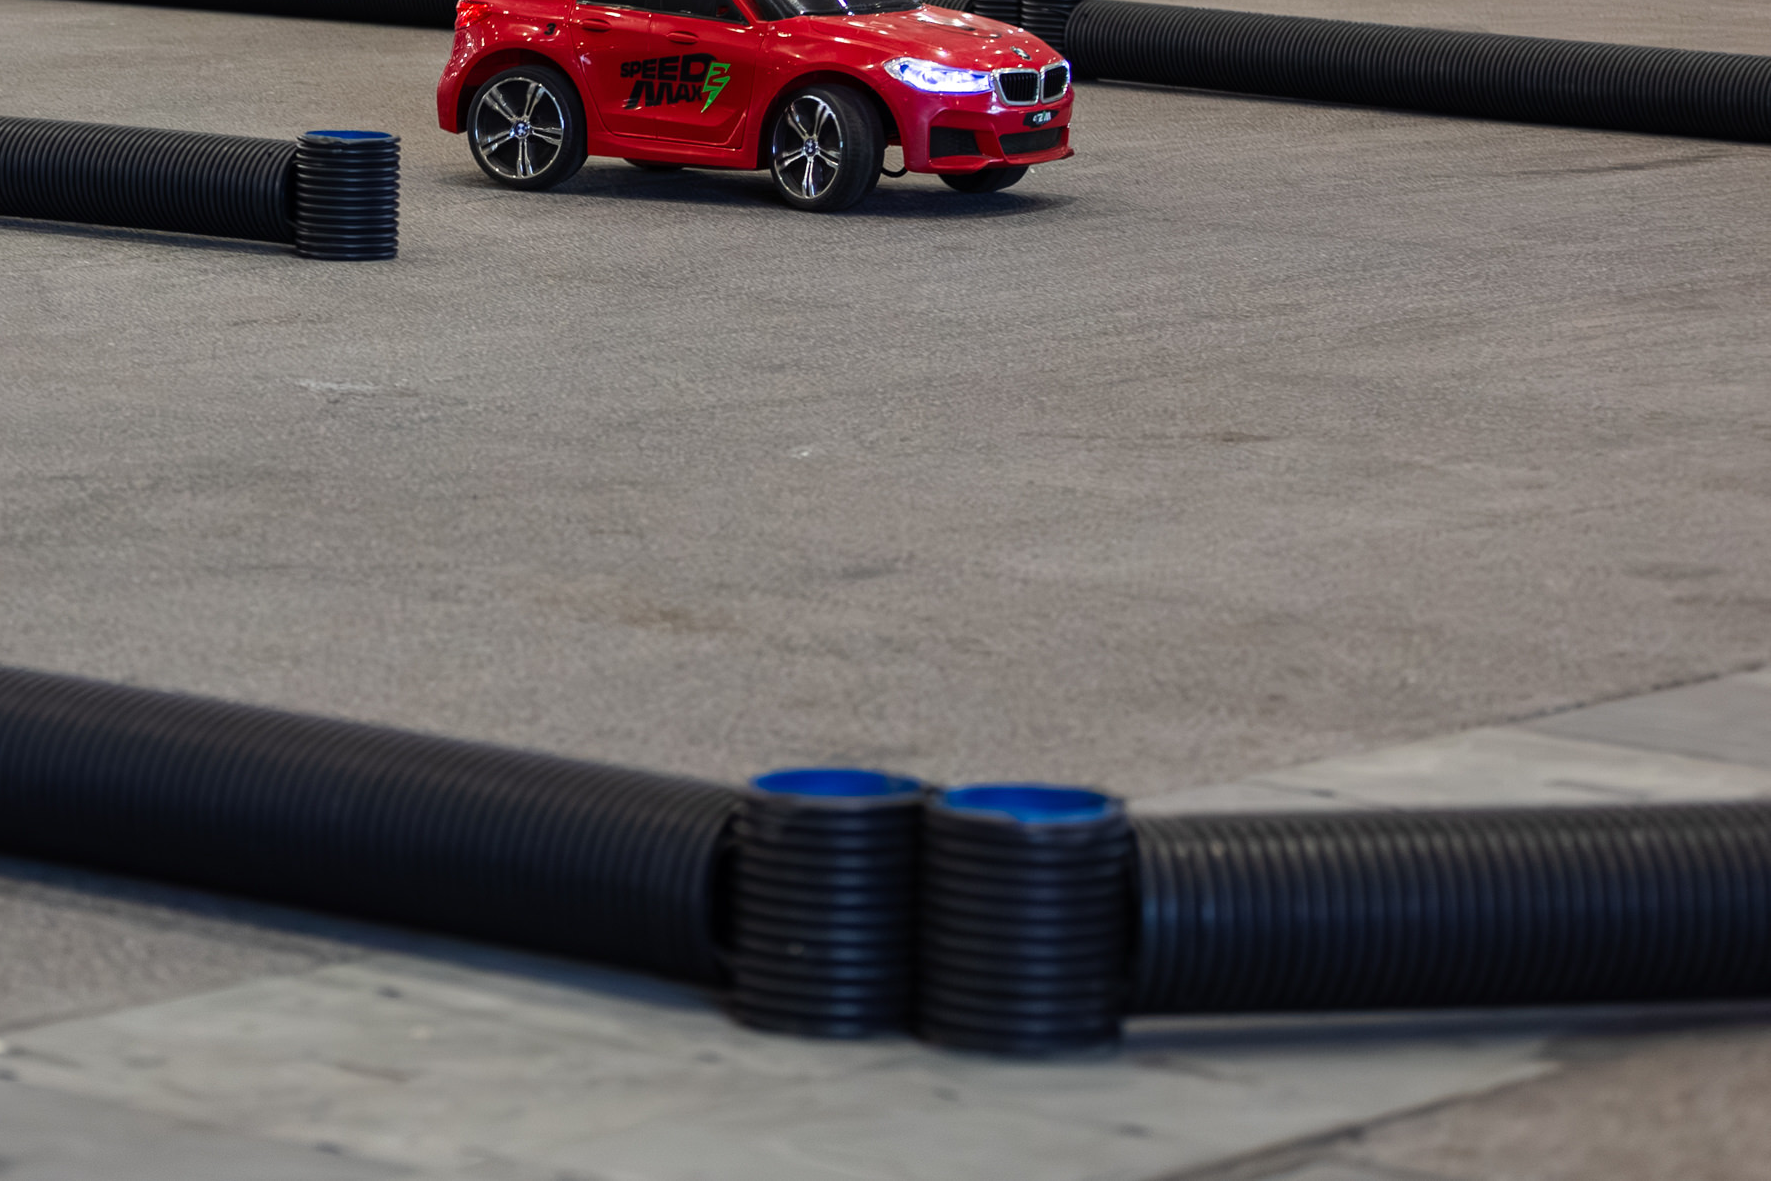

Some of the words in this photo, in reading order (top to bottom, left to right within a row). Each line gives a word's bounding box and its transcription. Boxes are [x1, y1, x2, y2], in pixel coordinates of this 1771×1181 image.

[544, 23, 556, 36] 3
[620, 53, 717, 84] SPEED
[624, 80, 703, 110] MAX
